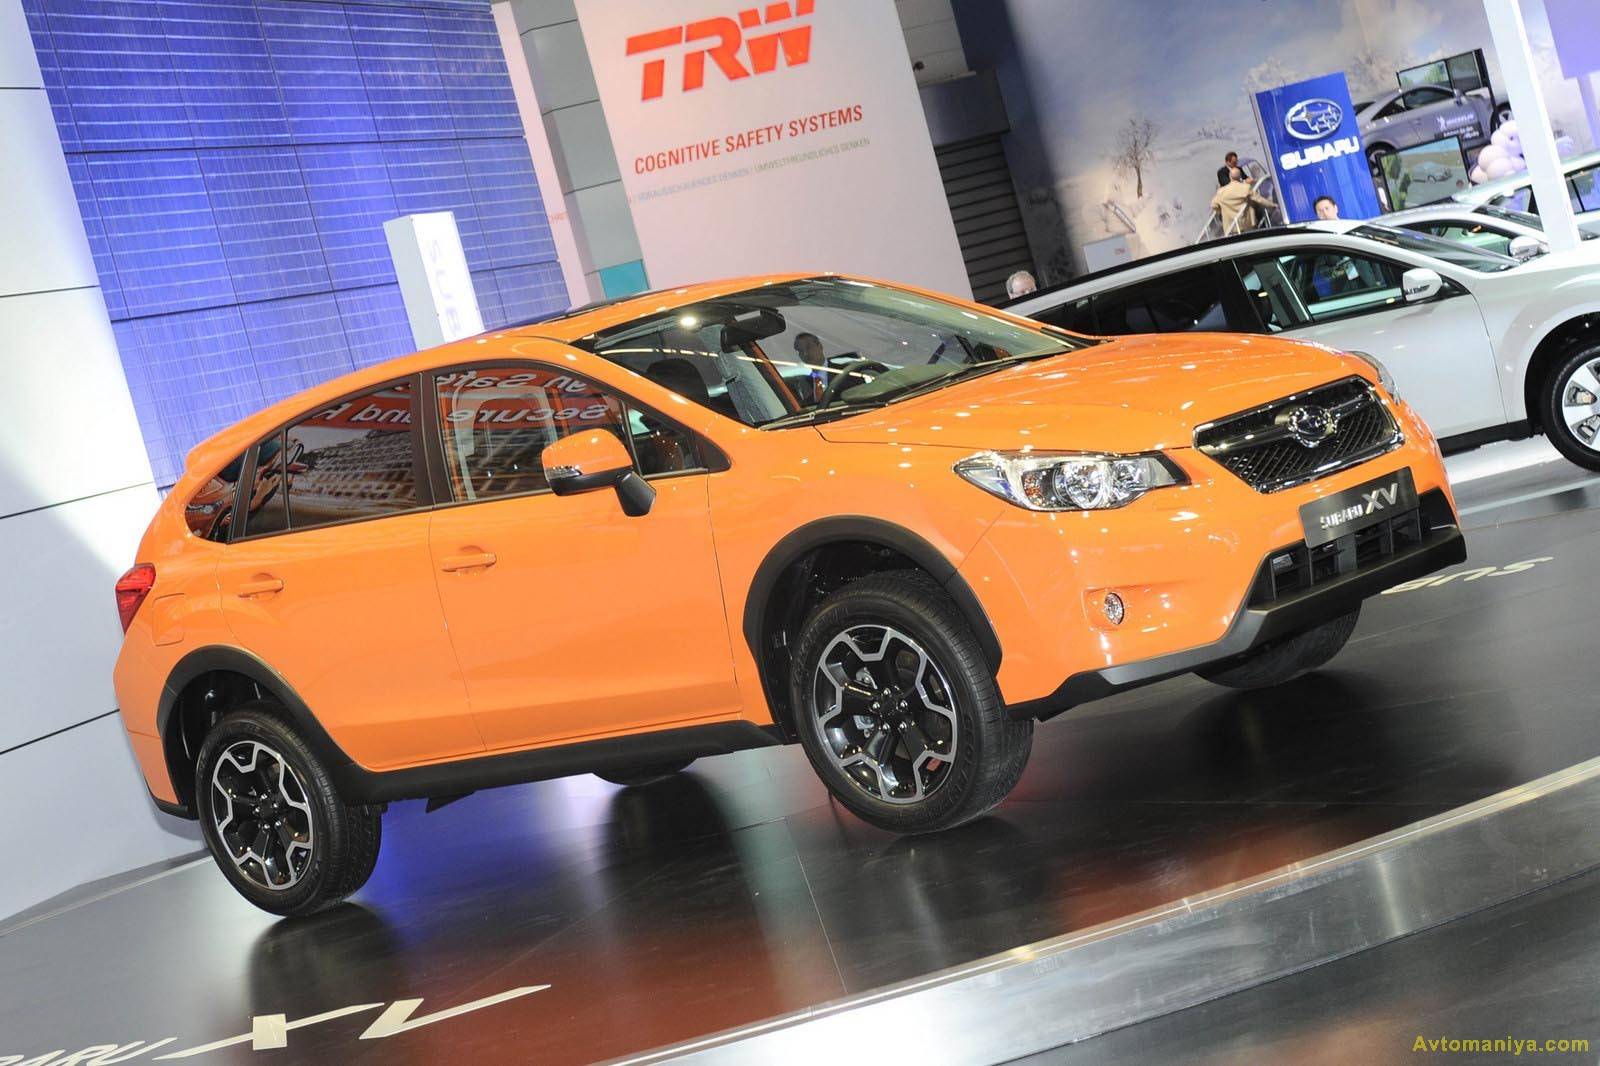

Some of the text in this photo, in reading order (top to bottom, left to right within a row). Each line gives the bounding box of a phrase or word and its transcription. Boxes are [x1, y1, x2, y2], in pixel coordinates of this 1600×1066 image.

[626, 0, 816, 102] TRW
[634, 104, 863, 175] COGNITIVE SAFETY SYSTEMS
[1279, 135, 1361, 171] SUBARU
[1320, 483, 1399, 529] SUBARU XV
